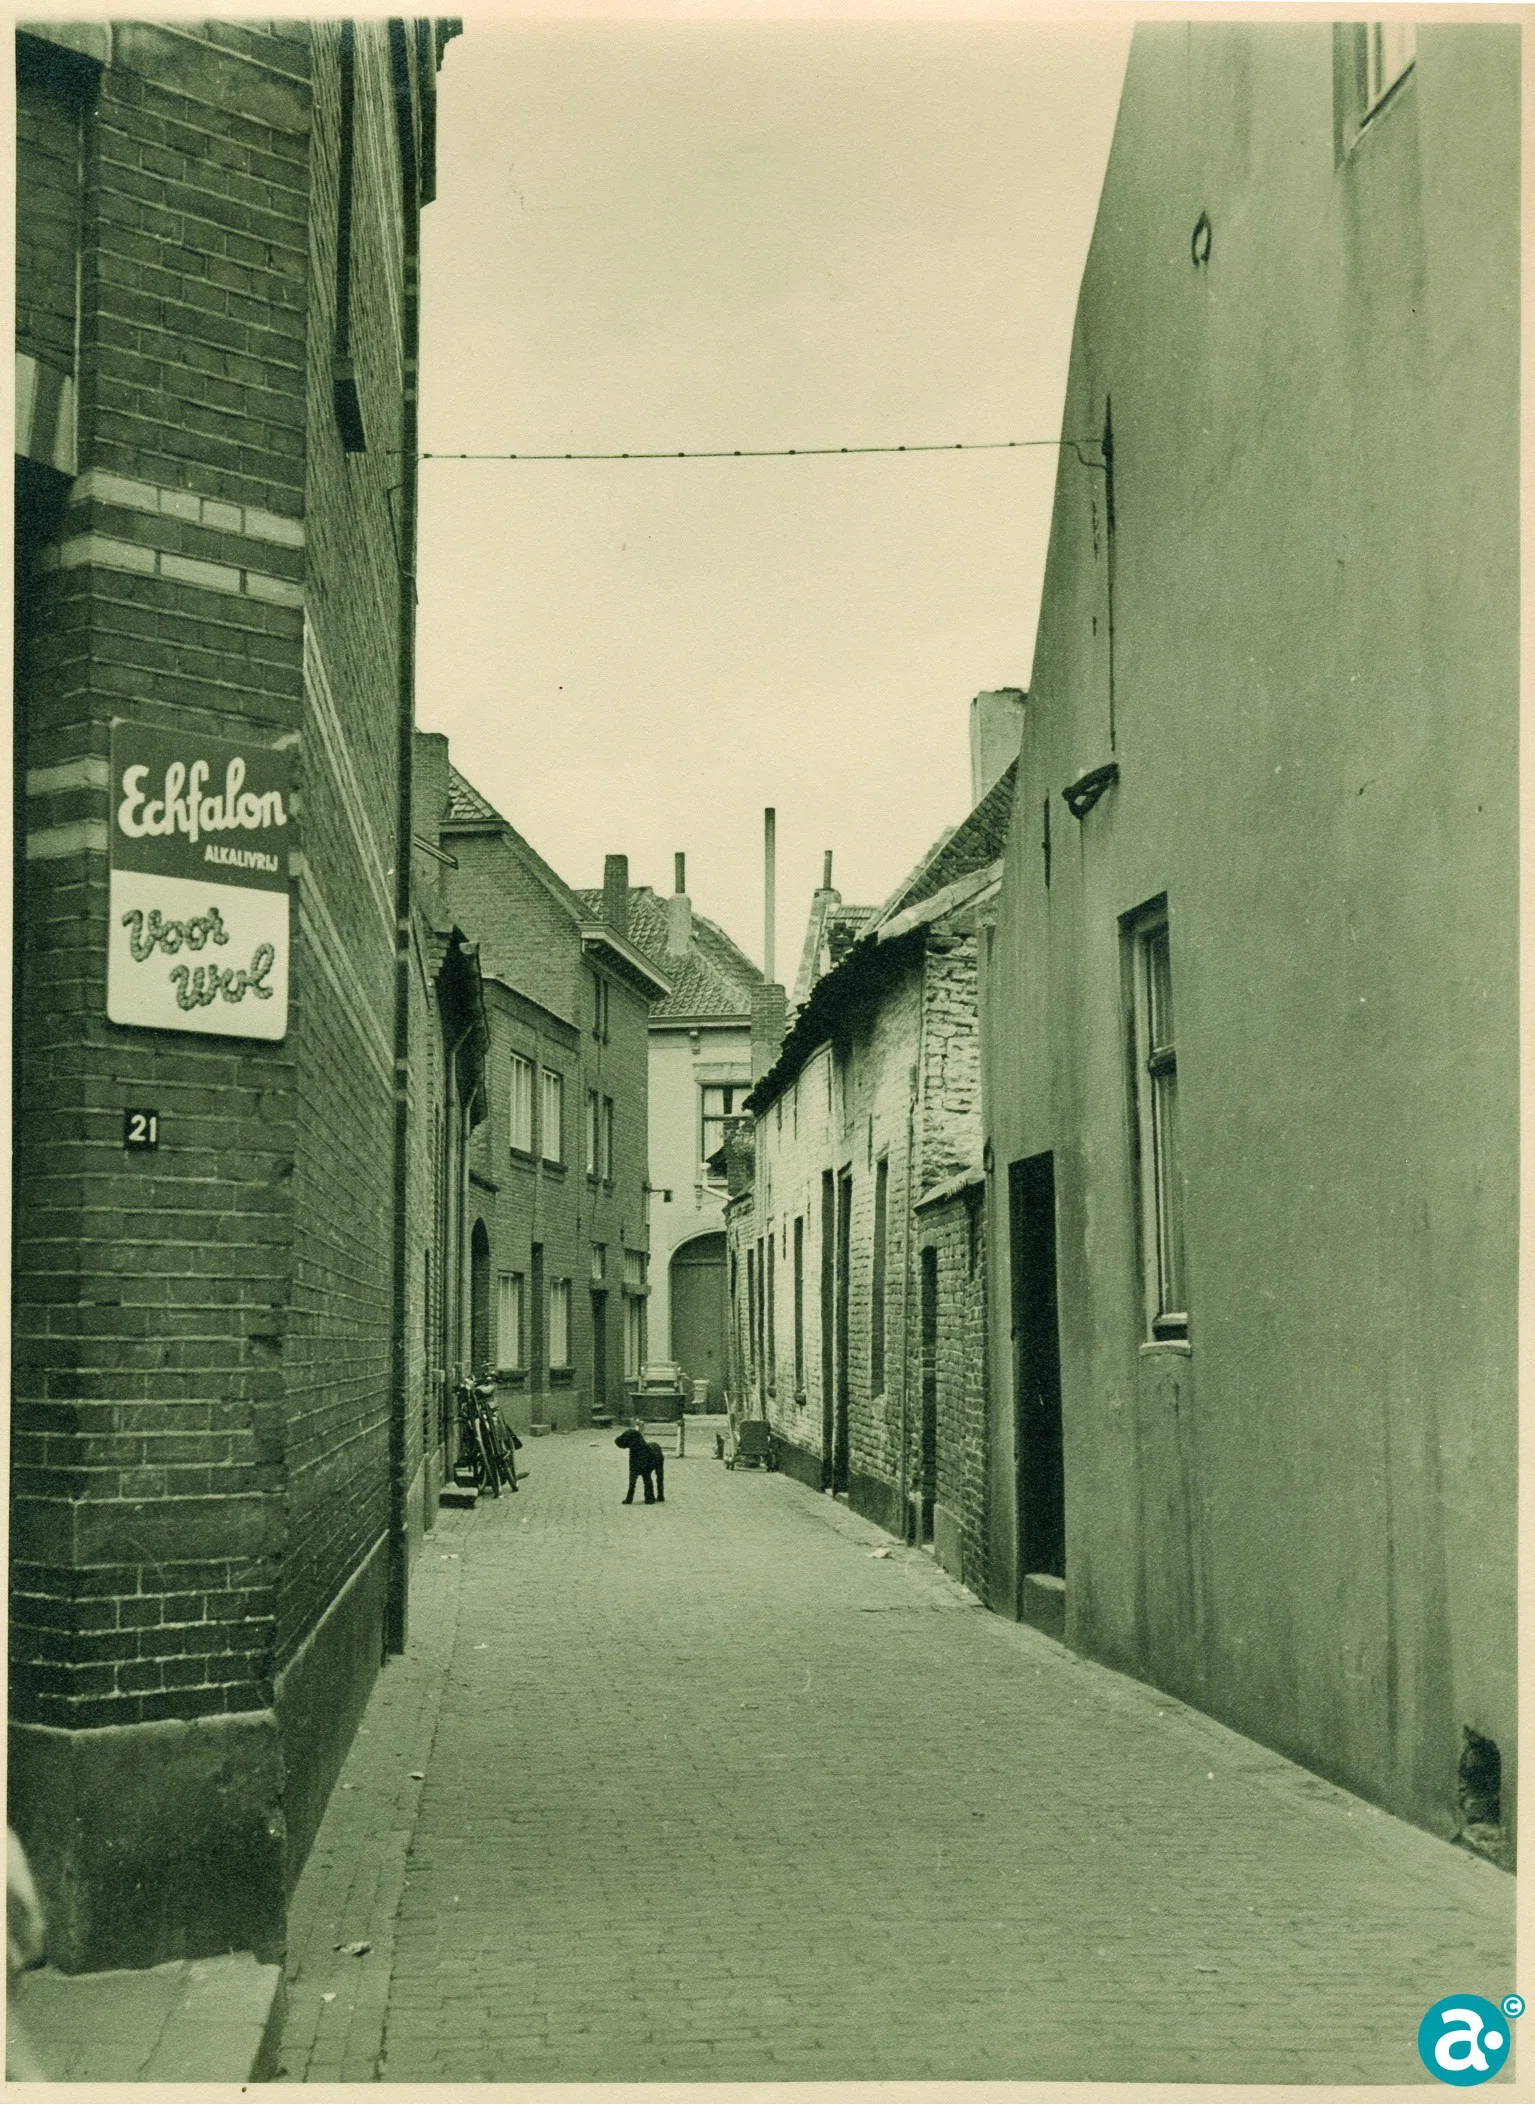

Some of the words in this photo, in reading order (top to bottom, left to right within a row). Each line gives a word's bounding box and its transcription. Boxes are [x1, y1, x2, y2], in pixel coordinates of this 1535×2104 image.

[118, 757, 287, 843] Echfalon
[204, 844, 278, 872] ALKALIVRIJ
[128, 1114, 157, 1143] 21
